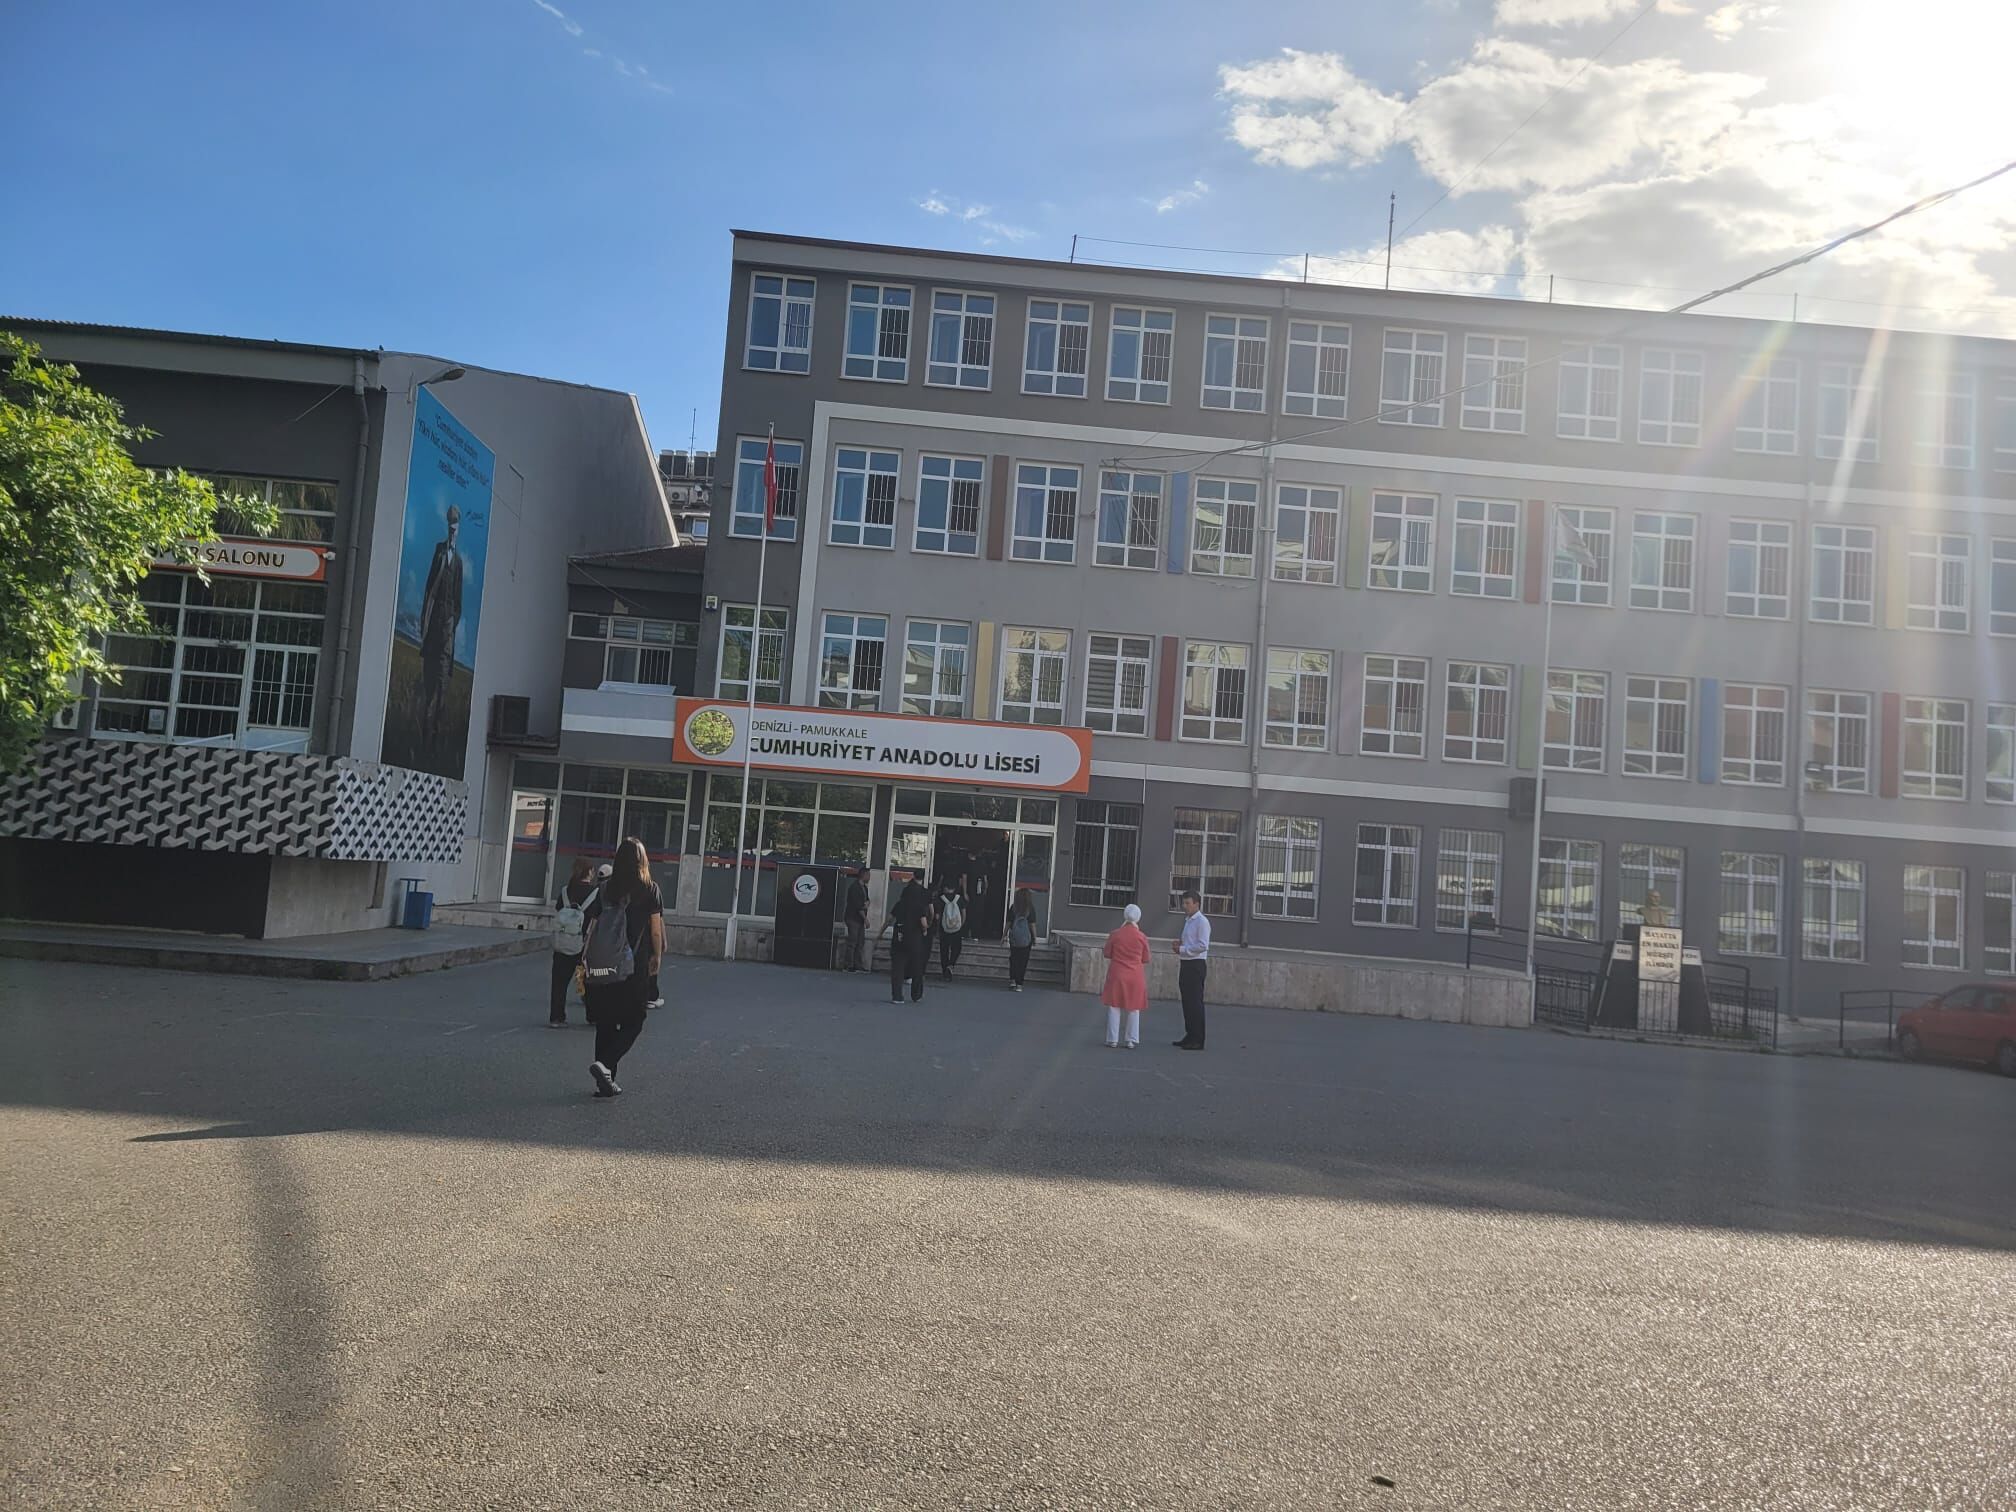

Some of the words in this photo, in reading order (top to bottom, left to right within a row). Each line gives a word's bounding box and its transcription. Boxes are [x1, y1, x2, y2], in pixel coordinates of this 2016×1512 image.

[206, 547, 285, 568] SALONU
[751, 720, 792, 733] DENİZLİ
[800, 724, 868, 739] PAMUKKALE
[880, 747, 978, 769] ANADOLU
[985, 751, 1041, 774] LİSESİ
